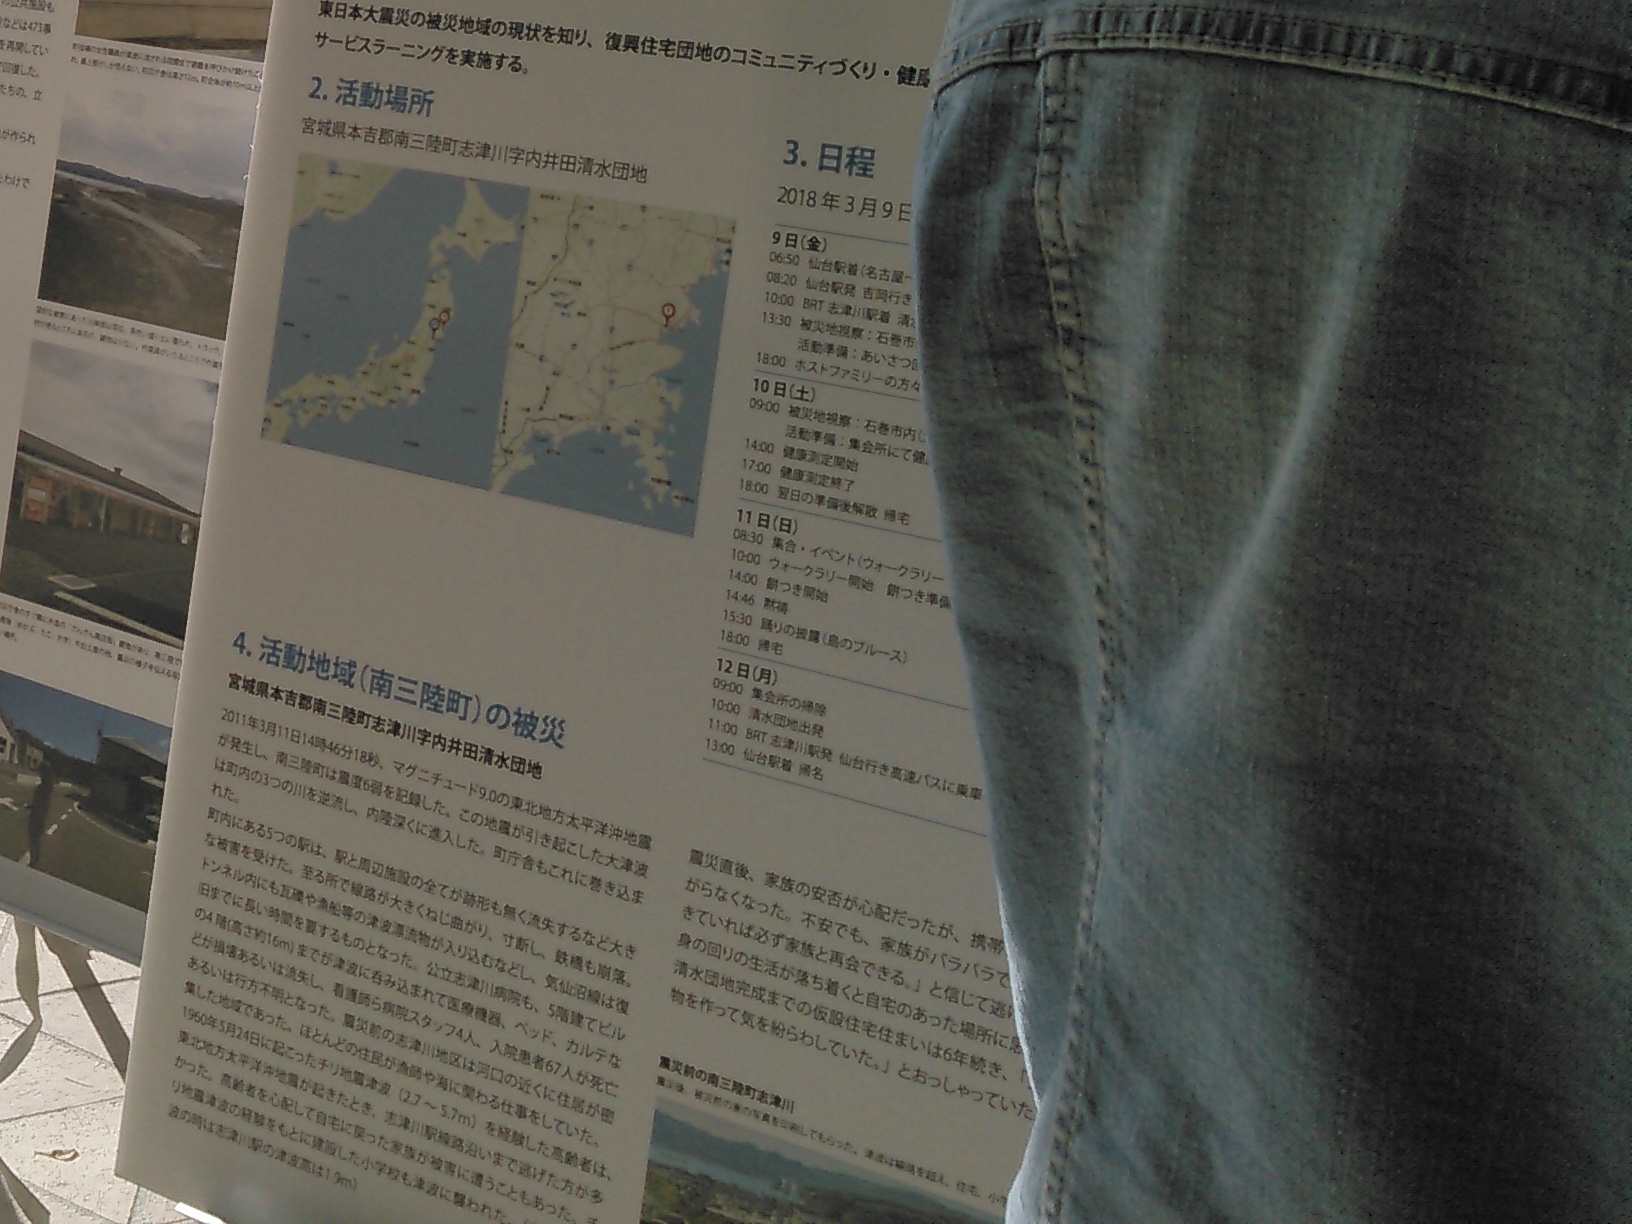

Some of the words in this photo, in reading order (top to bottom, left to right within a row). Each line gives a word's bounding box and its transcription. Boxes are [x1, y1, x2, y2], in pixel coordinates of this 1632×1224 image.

[314, 32, 529, 75] サービスラーニングを実施する。
[308, 76, 328, 102] 2.
[335, 77, 435, 117] 活動場所
[301, 116, 648, 184] 宮城県本吉郡南三陸町志津川字内井田清水団地
[782, 139, 807, 168] 3.
[817, 142, 876, 179] 日程
[769, 251, 800, 267] 06:50
[766, 271, 797, 287] 08:20
[805, 277, 857, 298] 仙台駅発
[762, 311, 791, 327] 13:30
[765, 291, 794, 307] 10:00
[802, 297, 825, 312] BRT
[827, 302, 891, 325] 志津川駅着
[756, 352, 786, 368] 18:00
[749, 397, 780, 414] 09:00
[745, 438, 774, 454] 14:00
[783, 445, 859, 473] 健康測定開始
[742, 458, 771, 475] 17:00
[780, 465, 855, 492] 健康測定終了
[740, 478, 769, 495] 18:00
[777, 485, 878, 520] 翌日の準備後解散
[883, 508, 910, 526] 帰宅
[733, 528, 764, 545] 08:30
[728, 569, 758, 586] 14:00
[766, 576, 829, 604] 餅つき開始
[731, 548, 760, 566] 10:00
[769, 557, 874, 593] ウォークラリー開始
[726, 589, 755, 606] 14:46
[723, 609, 752, 627] 15:30
[232, 631, 252, 657] 4.
[720, 629, 750, 647] 18:00
[757, 638, 784, 656] 帰宅
[713, 677, 744, 695] 09:00
[751, 686, 827, 718] 集会所の掃除
[227, 672, 543, 781] 宮城県本吉郡南三陸町志津川字内井田清水団地
[711, 698, 740, 716] 10:00
[748, 707, 824, 739] 清水団地出発
[705, 738, 735, 756] 13:00
[743, 747, 792, 773] 仙台駅着
[708, 718, 738, 736] 11:00
[745, 727, 768, 744] BRT
[769, 734, 833, 763] 志津川駅発
[211, 782, 239, 804] れた。
[658, 1055, 795, 1114] 震災前の南三陸町志津川
